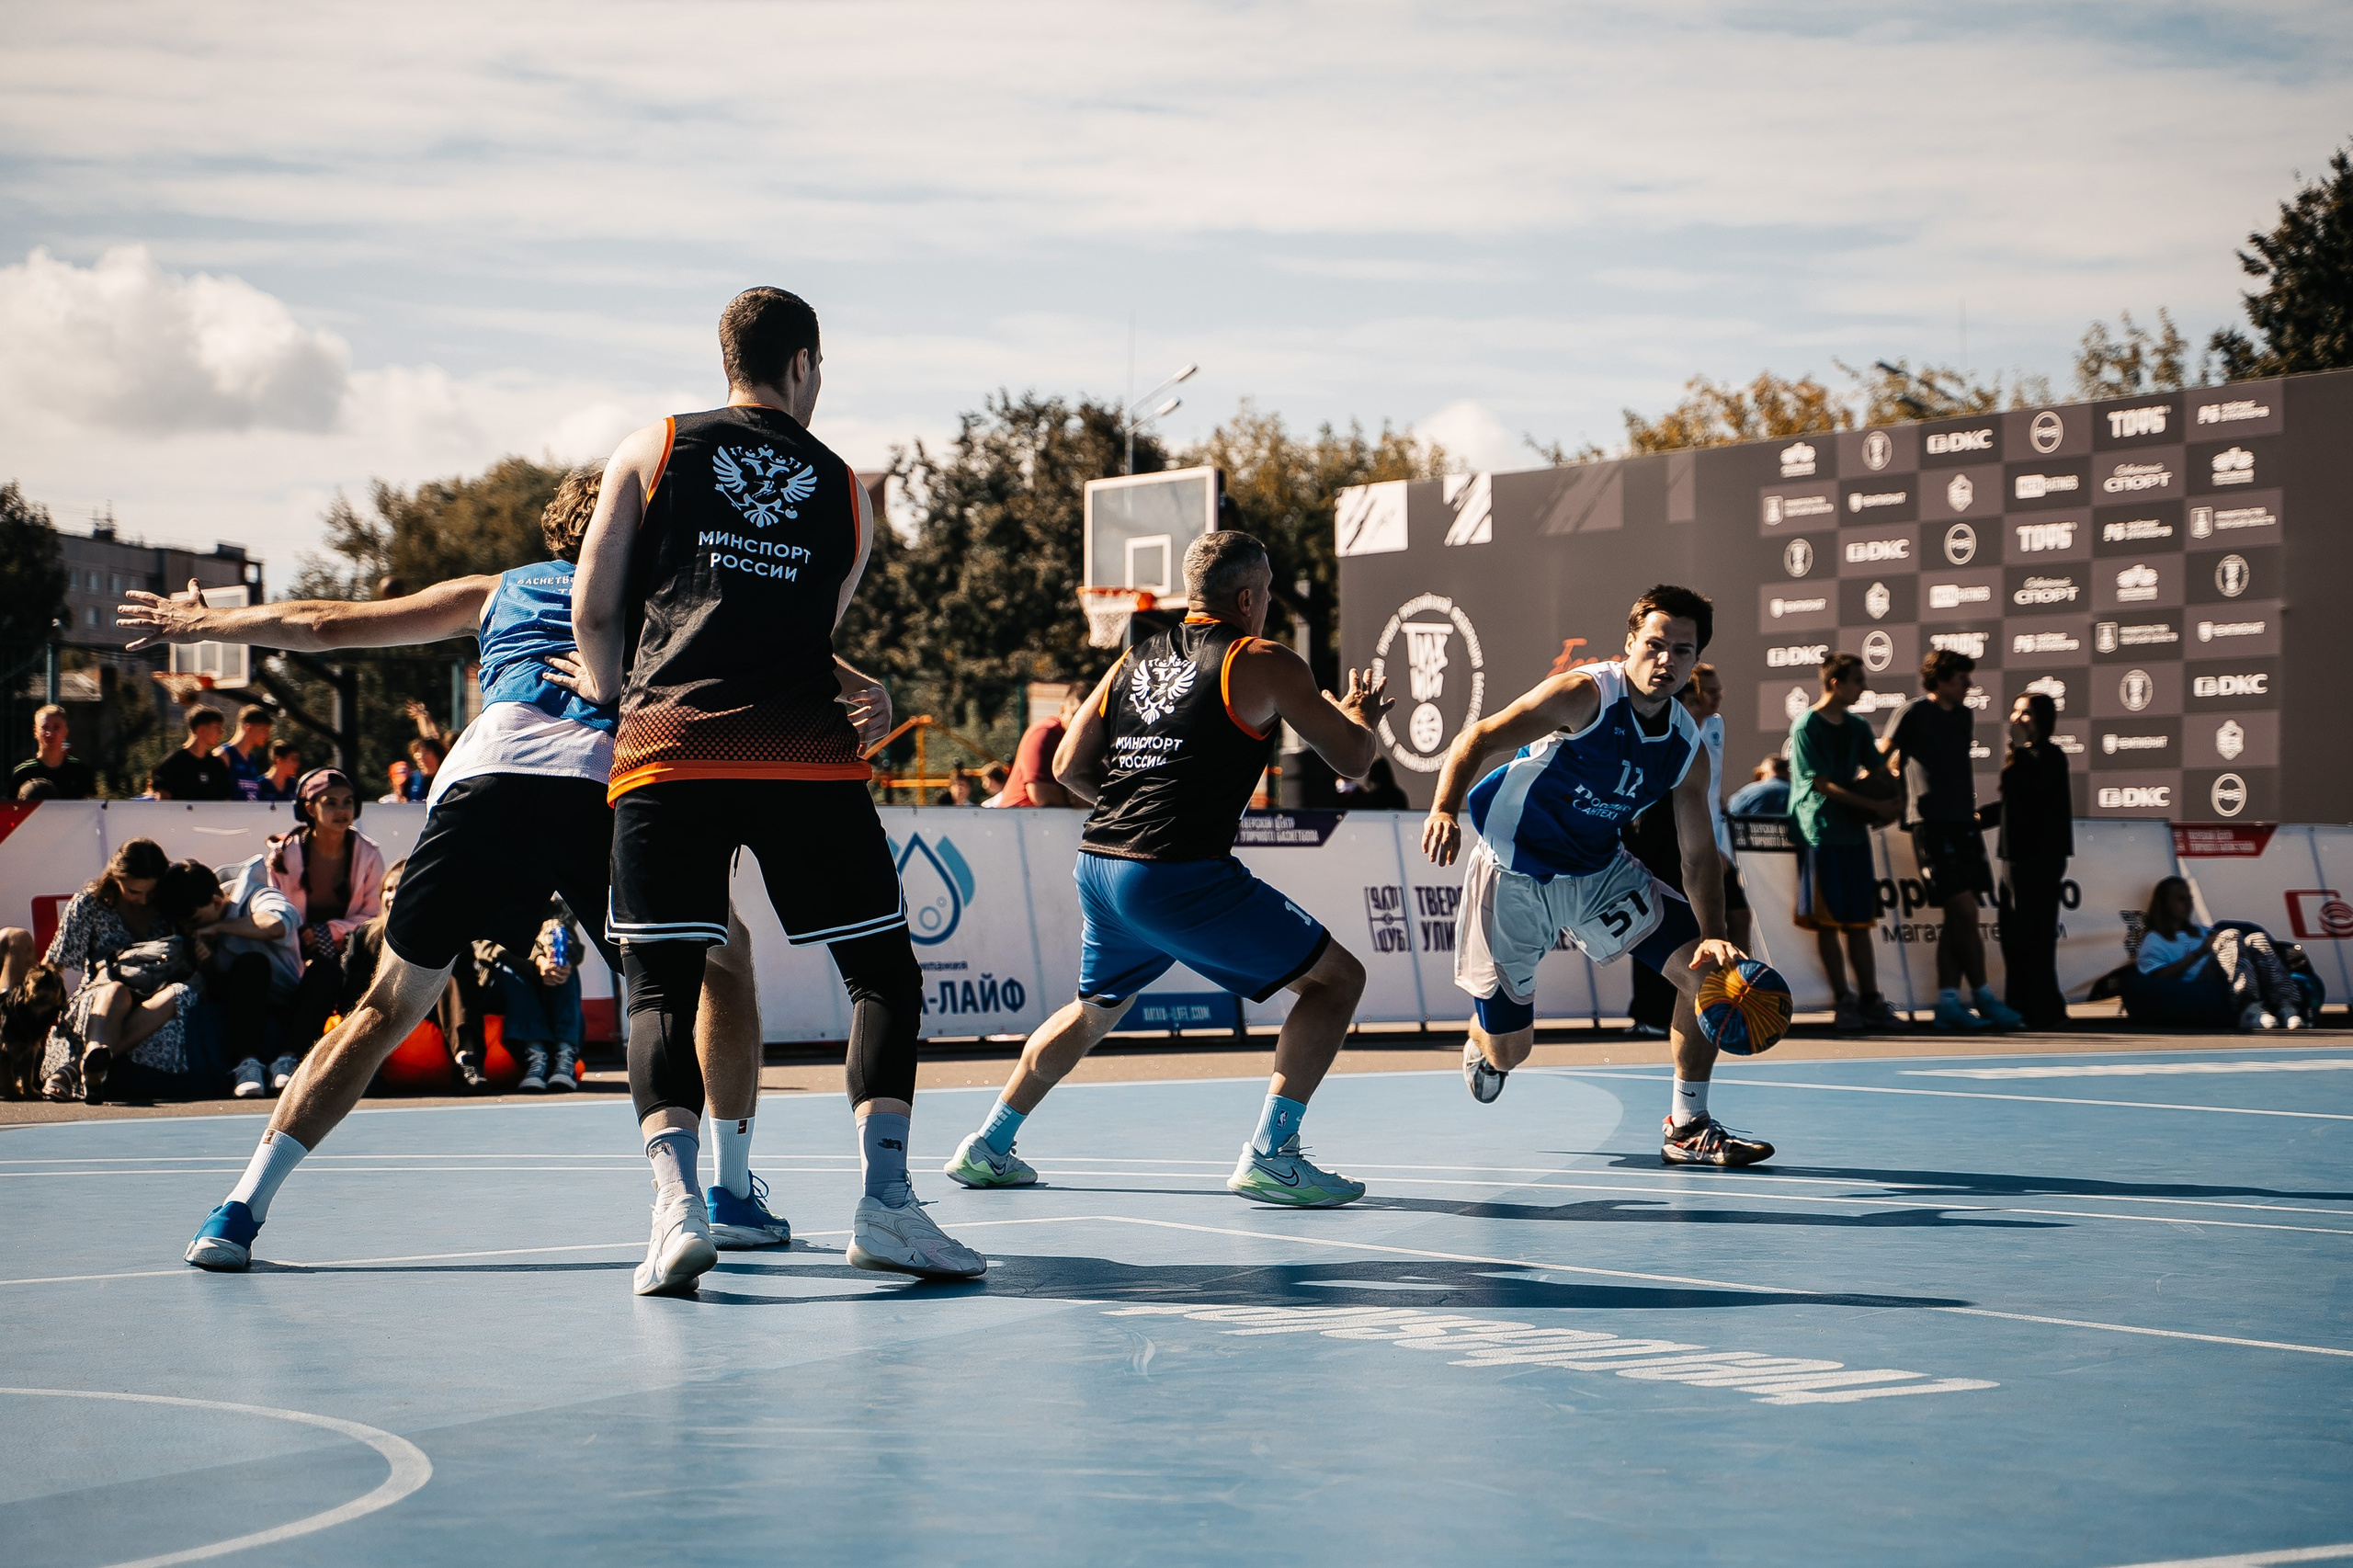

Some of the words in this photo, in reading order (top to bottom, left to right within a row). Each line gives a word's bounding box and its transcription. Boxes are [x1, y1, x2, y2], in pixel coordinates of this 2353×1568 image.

[1949, 428, 1994, 452] DKC
[2103, 472, 2173, 493] СПОРТ
[699, 530, 812, 564] МИНСПОРТ
[1866, 539, 1911, 562] DKC
[710, 552, 799, 583] РОССИИ
[2014, 586, 2080, 605] СПОРТ
[1788, 644, 1829, 665] DKC
[2217, 673, 2268, 696] DKC
[1115, 736, 1183, 752] МИНСПОРТ
[1120, 755, 1167, 768] РОССИИ
[1613, 759, 1643, 799] 12
[2121, 787, 2170, 808] DKC
[1284, 897, 1313, 926] 1
[1415, 886, 1463, 917] ТВЕР
[1598, 889, 1650, 939] 51
[1421, 921, 1456, 952] УЛИ
